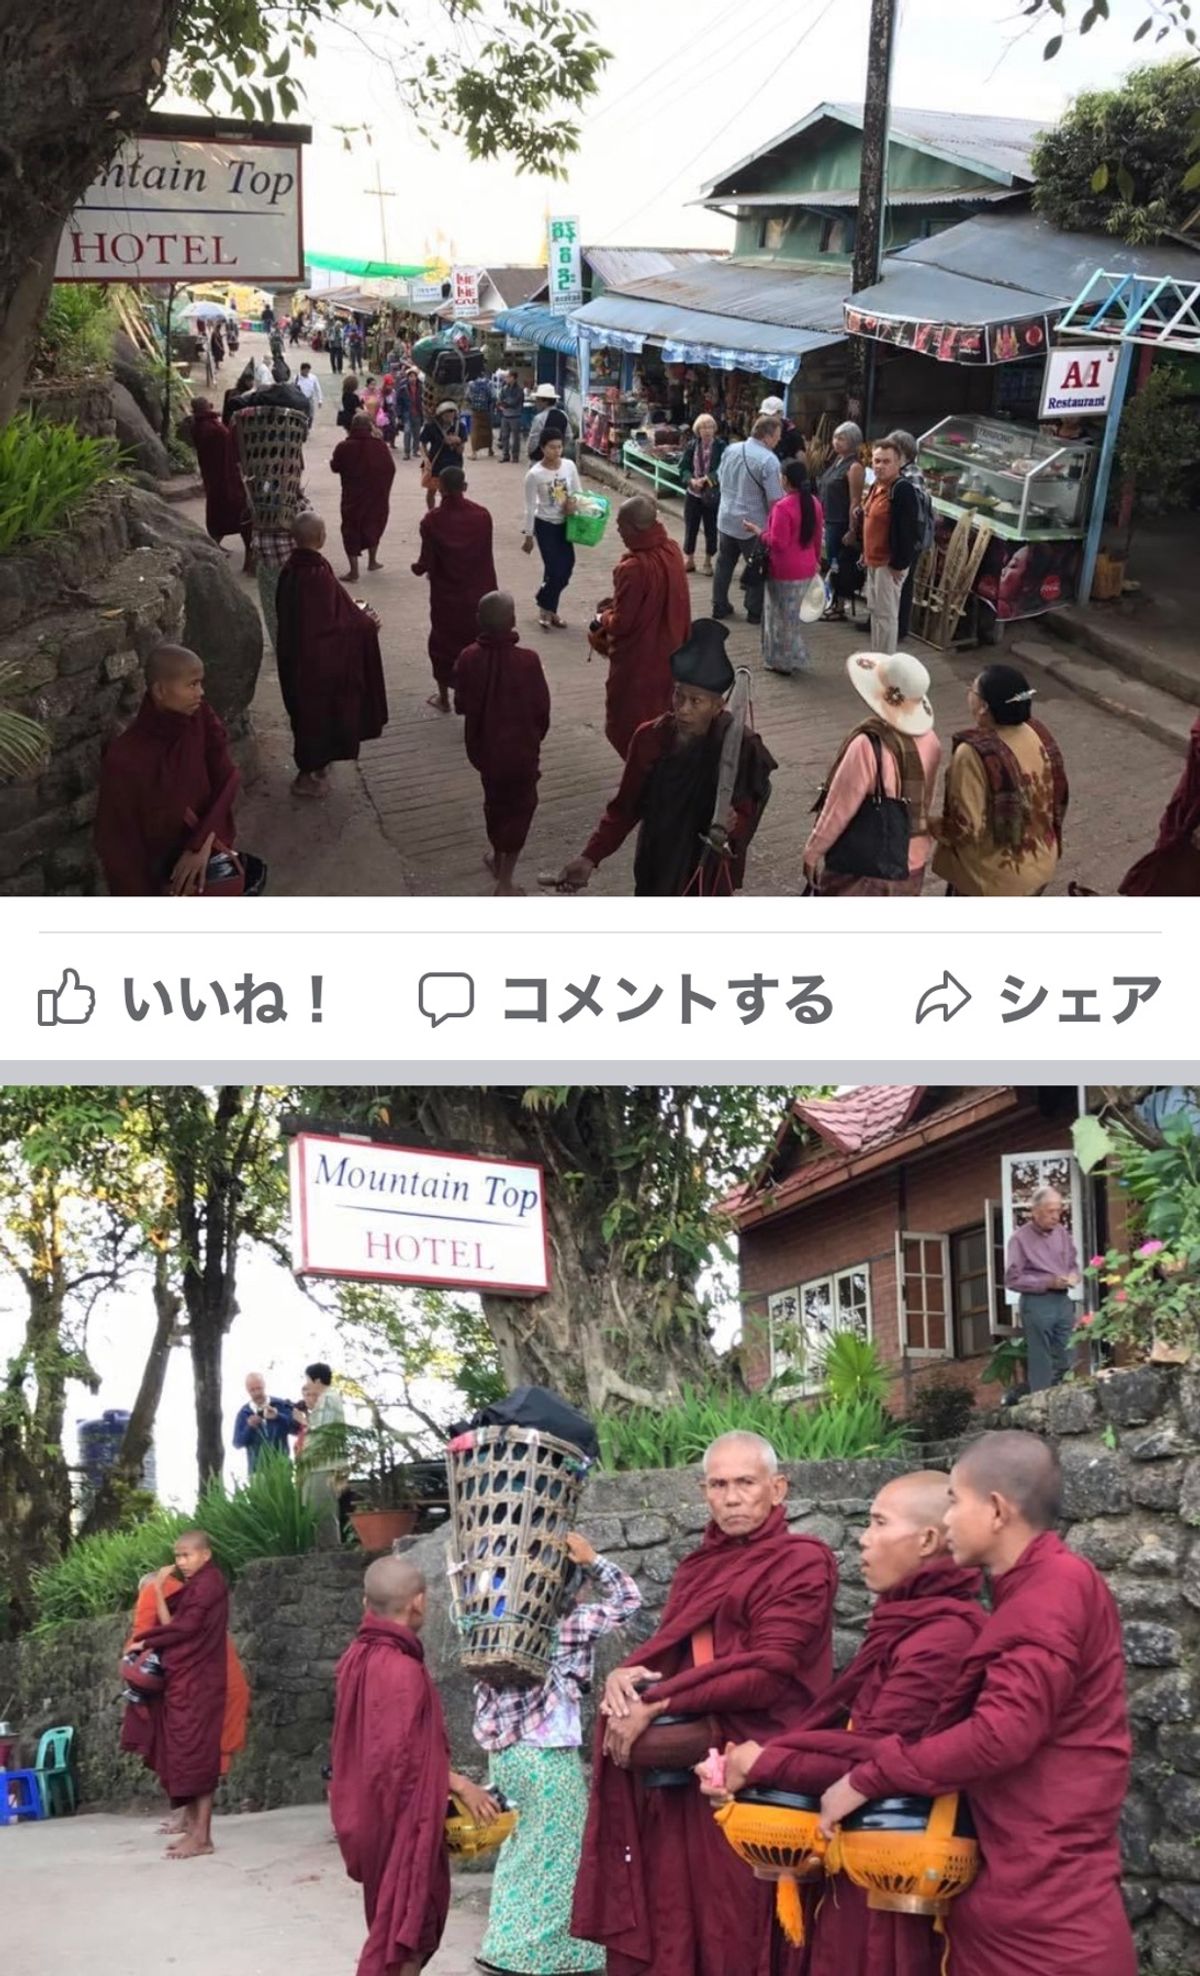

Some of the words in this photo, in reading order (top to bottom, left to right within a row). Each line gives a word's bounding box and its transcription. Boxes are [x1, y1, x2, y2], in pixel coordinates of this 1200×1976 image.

[91, 159, 207, 192] ntain
[228, 160, 294, 205] Top
[71, 232, 238, 265] HOTEL
[1060, 360, 1101, 388] A1
[1048, 396, 1106, 409] Restaurant
[315, 1154, 469, 1201] Mountain
[485, 1176, 538, 1217] Top
[366, 1232, 494, 1271] HOTEL
